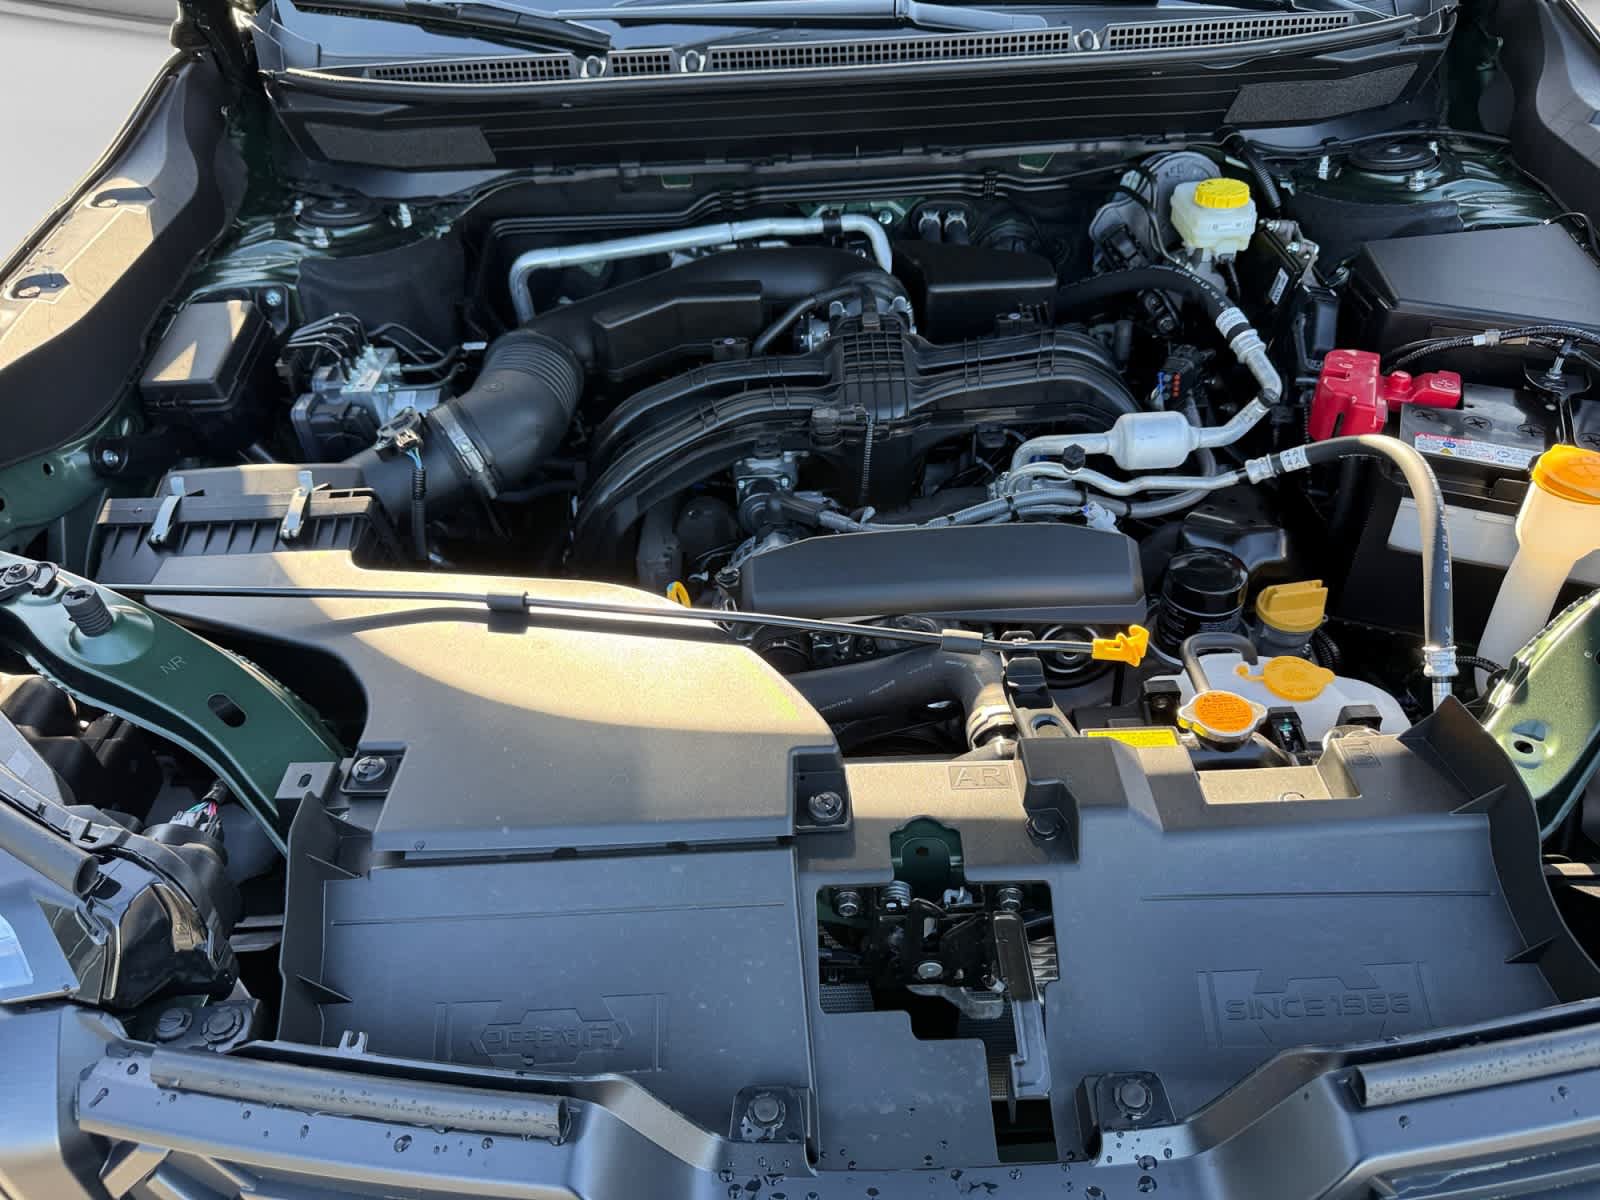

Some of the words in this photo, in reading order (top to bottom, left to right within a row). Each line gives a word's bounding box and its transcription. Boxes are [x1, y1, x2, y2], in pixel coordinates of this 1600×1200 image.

[160, 655, 186, 674] NR
[955, 767, 1006, 786] AR
[1226, 999, 1326, 1020] SINCE
